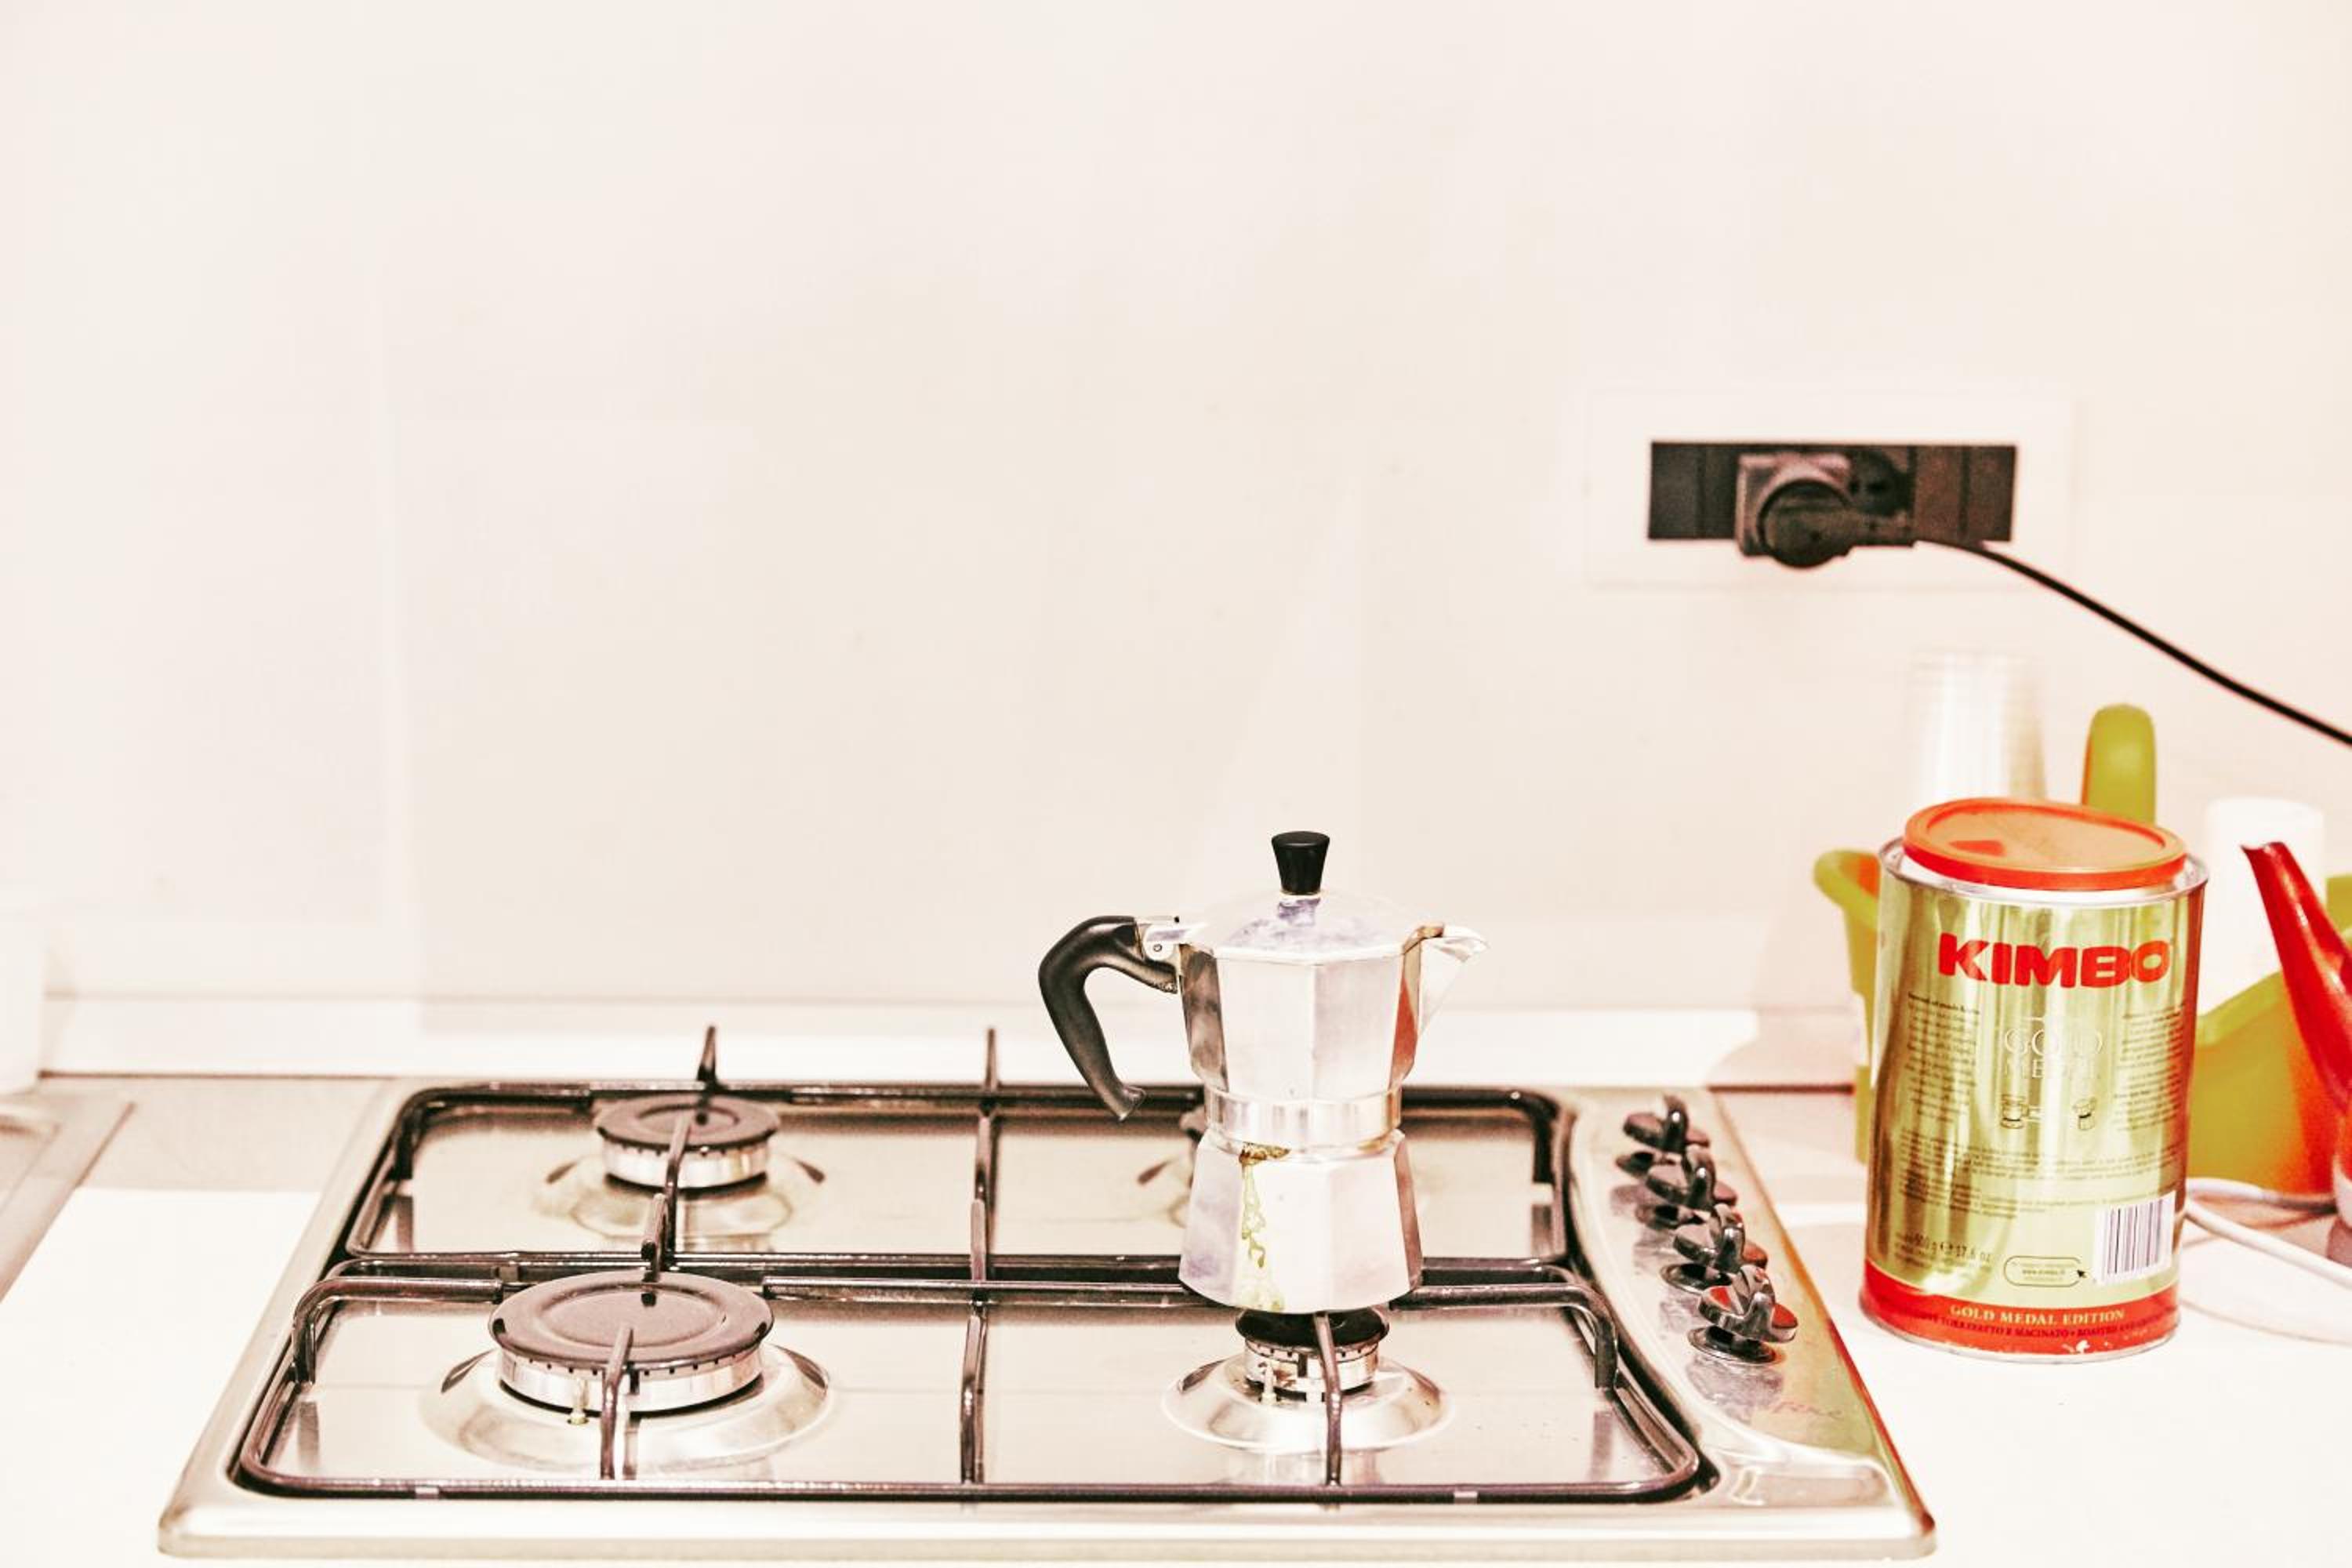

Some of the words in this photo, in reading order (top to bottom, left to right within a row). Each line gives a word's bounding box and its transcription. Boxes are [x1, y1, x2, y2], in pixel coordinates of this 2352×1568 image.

[1938, 932, 2170, 989] KIMBO
[1950, 1305, 1995, 1321] GOLD
[2001, 1312, 2056, 1326] MEDAL
[2063, 1310, 2125, 1326] EDITION
